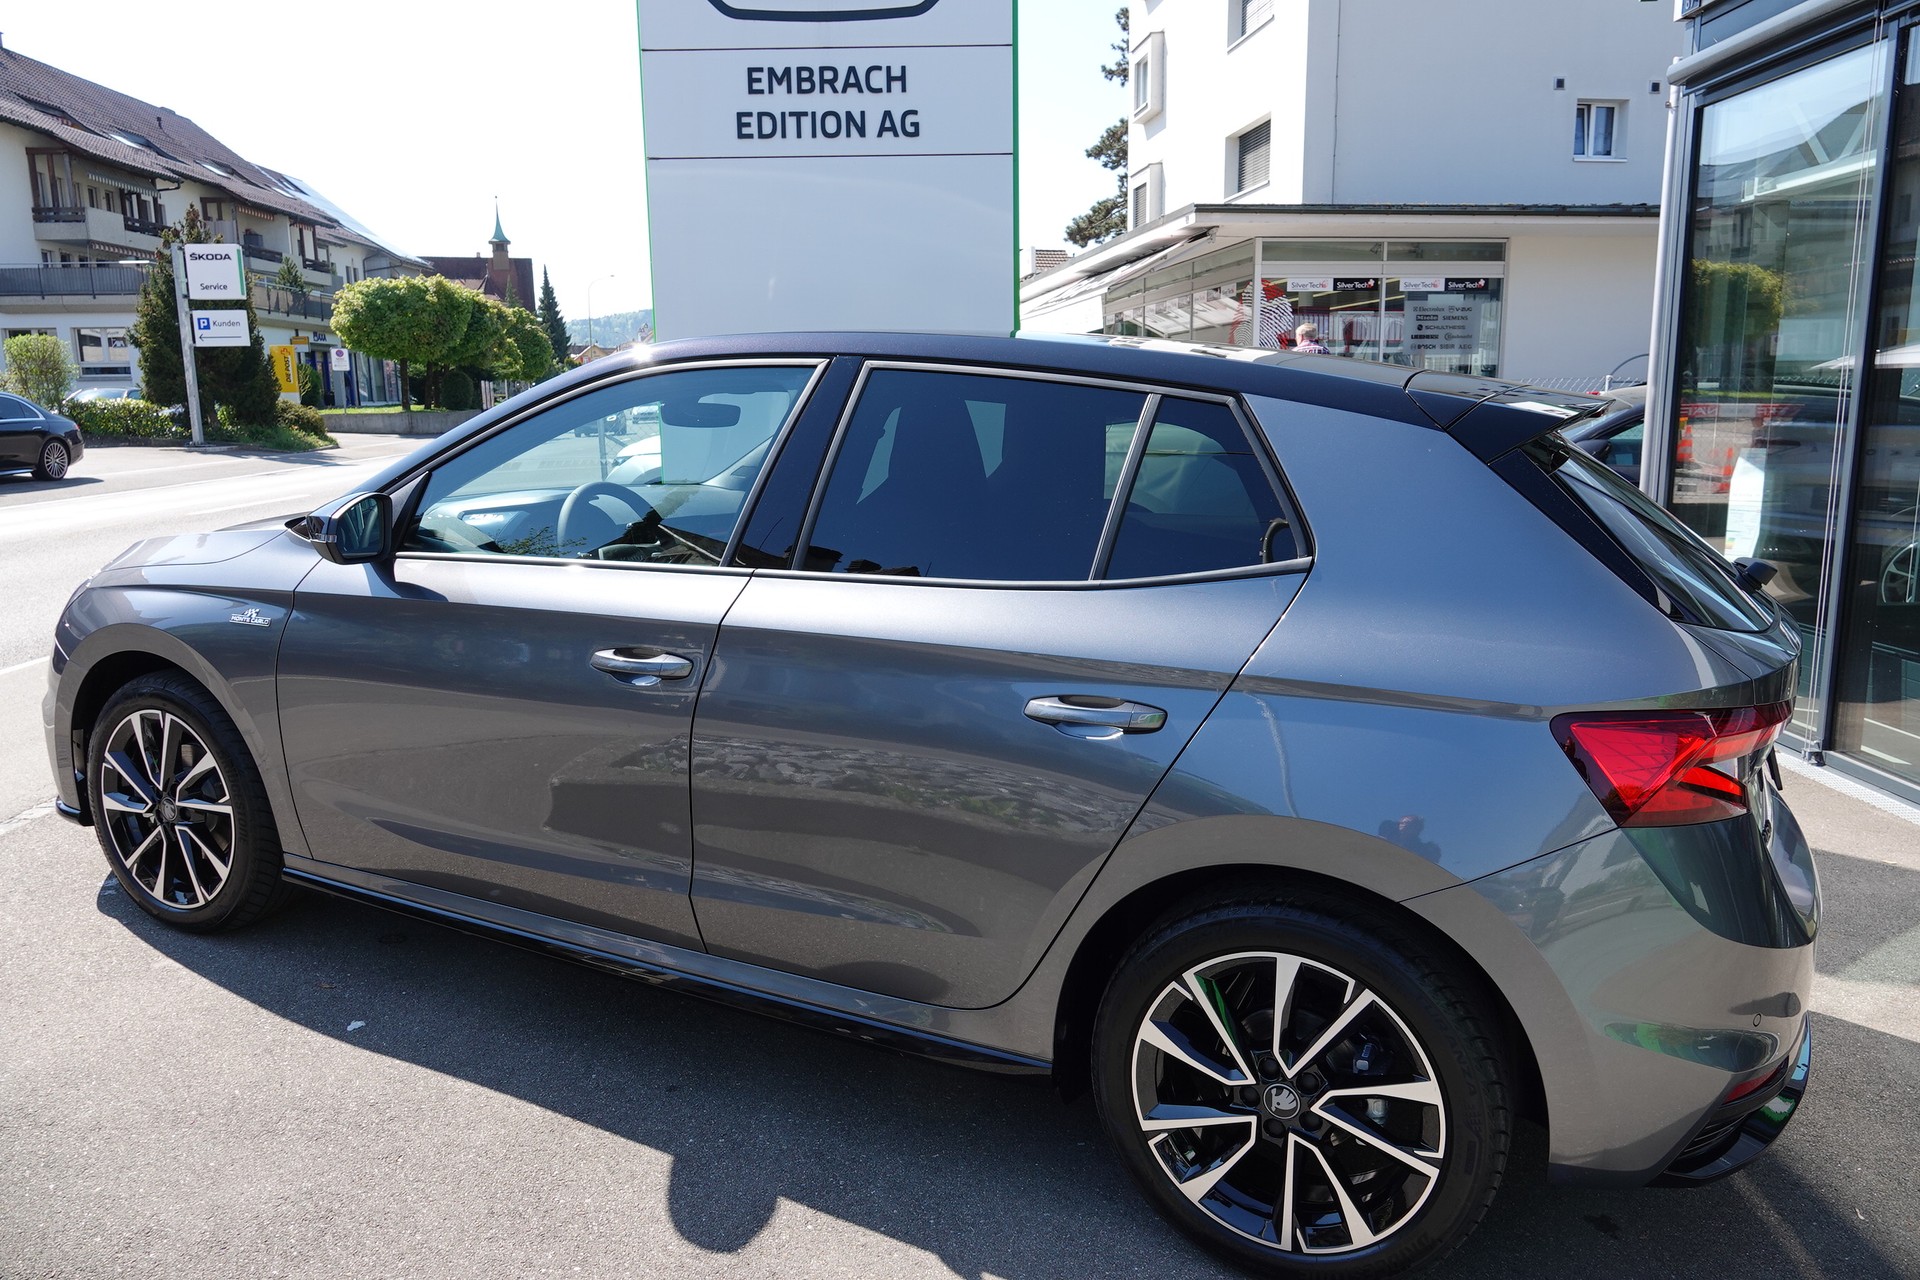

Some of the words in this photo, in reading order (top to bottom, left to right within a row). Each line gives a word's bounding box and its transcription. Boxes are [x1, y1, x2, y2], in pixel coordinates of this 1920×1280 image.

[747, 65, 907, 94] EMBRACH
[736, 110, 866, 139] EDITION
[876, 109, 920, 138] AG
[189, 252, 232, 261] ŠKODA
[212, 319, 241, 327] Kunden
[230, 615, 250, 623] MONTE
[250, 617, 270, 625] CARLO
